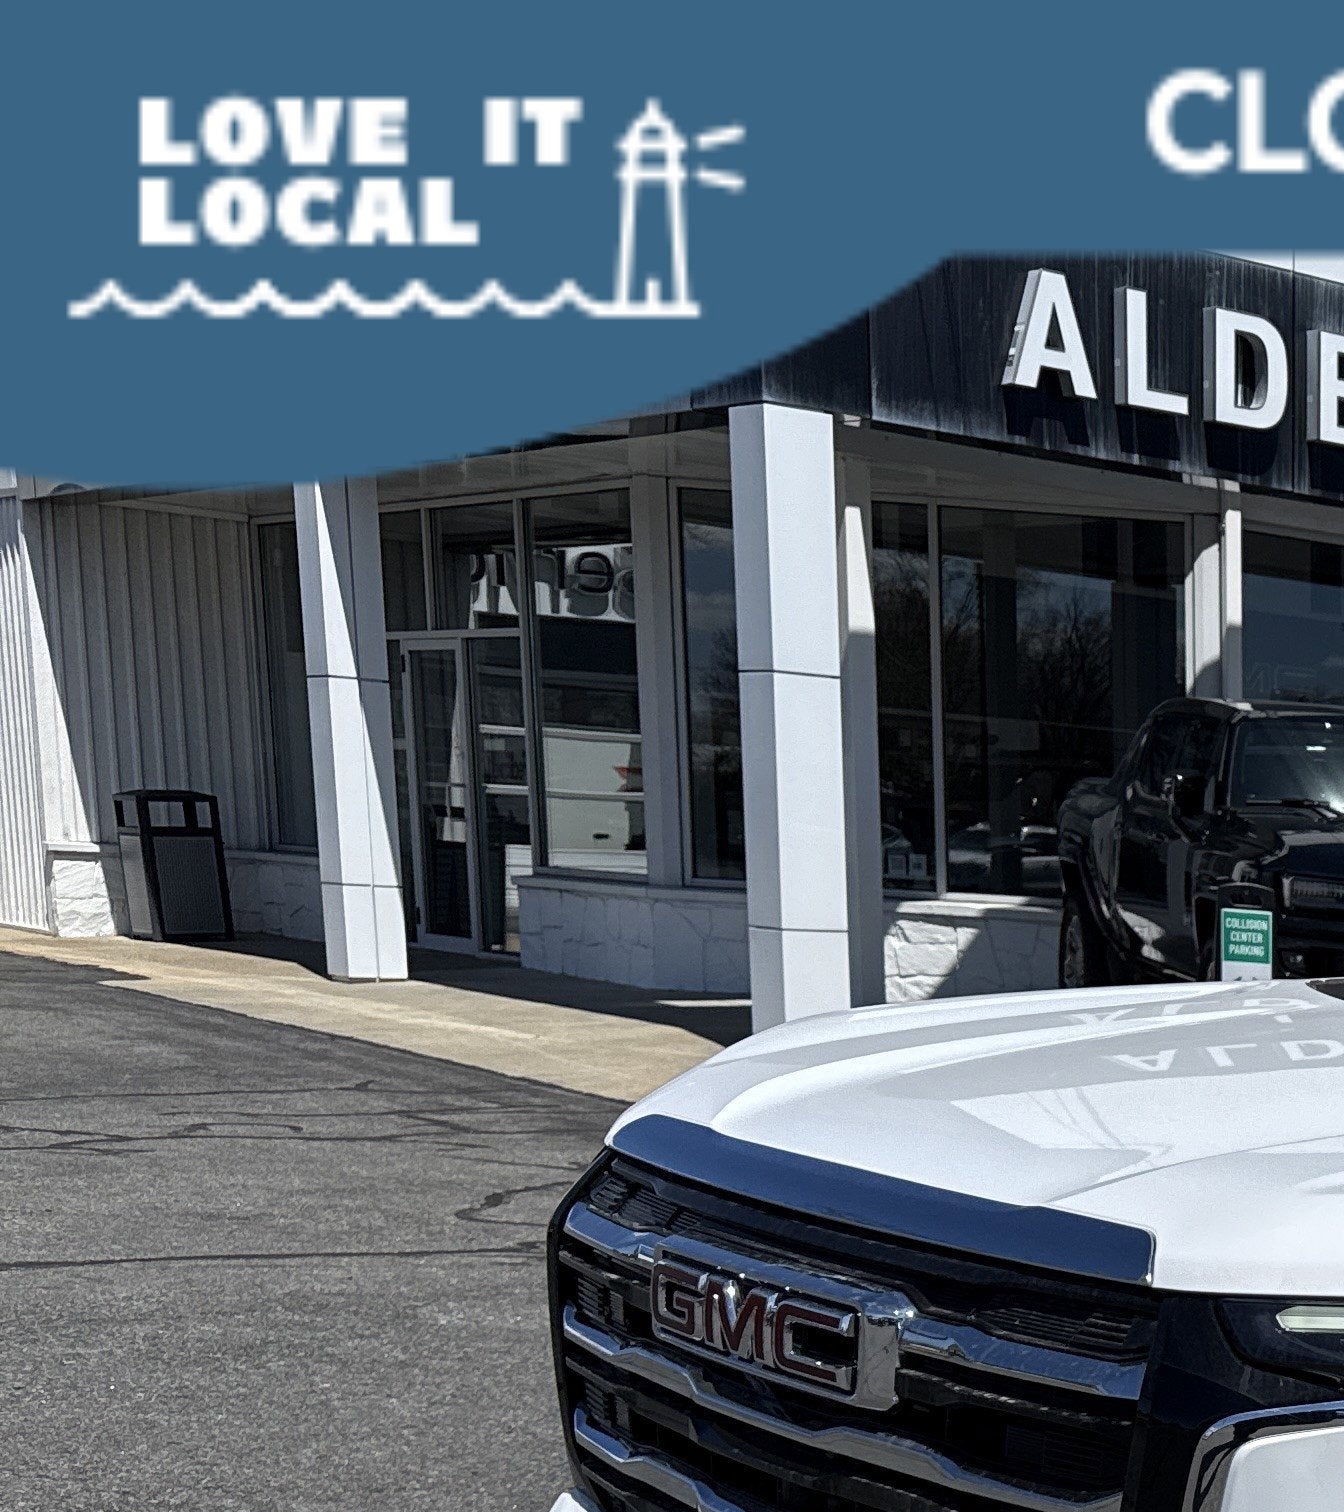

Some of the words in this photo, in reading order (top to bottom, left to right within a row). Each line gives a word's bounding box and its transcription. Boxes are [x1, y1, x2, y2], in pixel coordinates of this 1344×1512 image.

[1225, 917, 1268, 931] COLLISION
[1230, 931, 1263, 944] CENTER
[1228, 944, 1264, 957] PARKING
[651, 1259, 856, 1393] GMC
